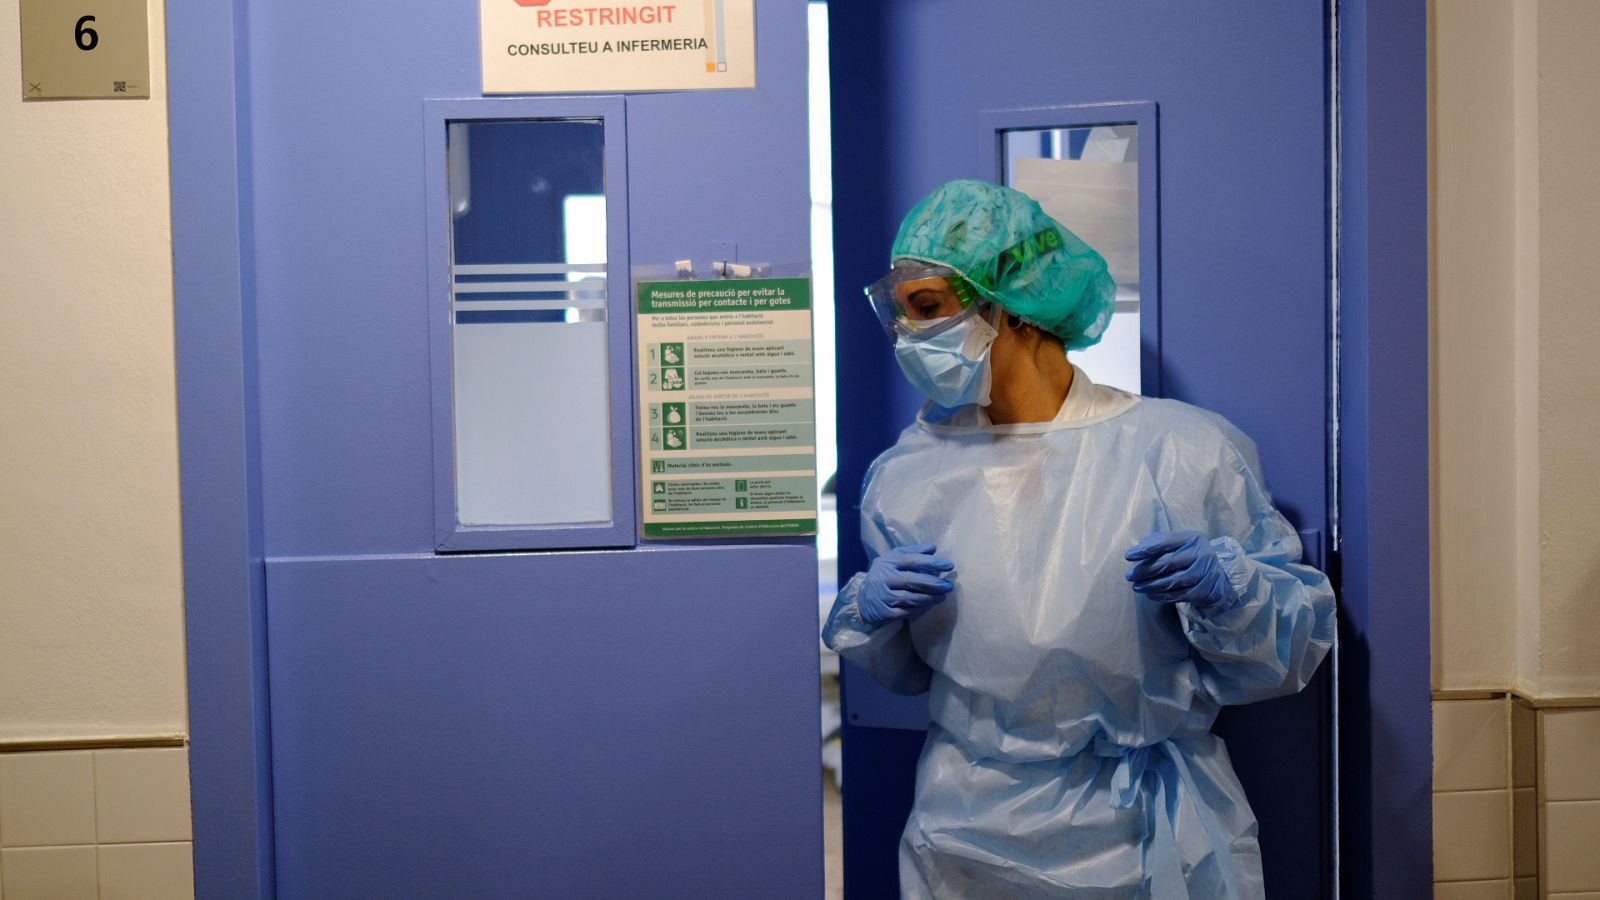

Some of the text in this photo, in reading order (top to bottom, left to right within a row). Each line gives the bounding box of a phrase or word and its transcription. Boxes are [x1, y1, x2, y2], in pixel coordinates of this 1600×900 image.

[537, 6, 676, 28] RESTRINGIT
[74, 15, 99, 51] 6
[507, 38, 708, 56] CONSULTEU A INFERMERIA
[651, 288, 785, 300] Mesures de precaució per evitar la
[651, 299, 696, 308] transmissió
[699, 300, 711, 309] per
[713, 298, 748, 306] contacte
[754, 299, 767, 308] per
[770, 297, 791, 307] gotes
[650, 349, 655, 359] 1
[650, 374, 657, 384] 2
[651, 409, 658, 419] 3
[651, 433, 658, 443] 4
